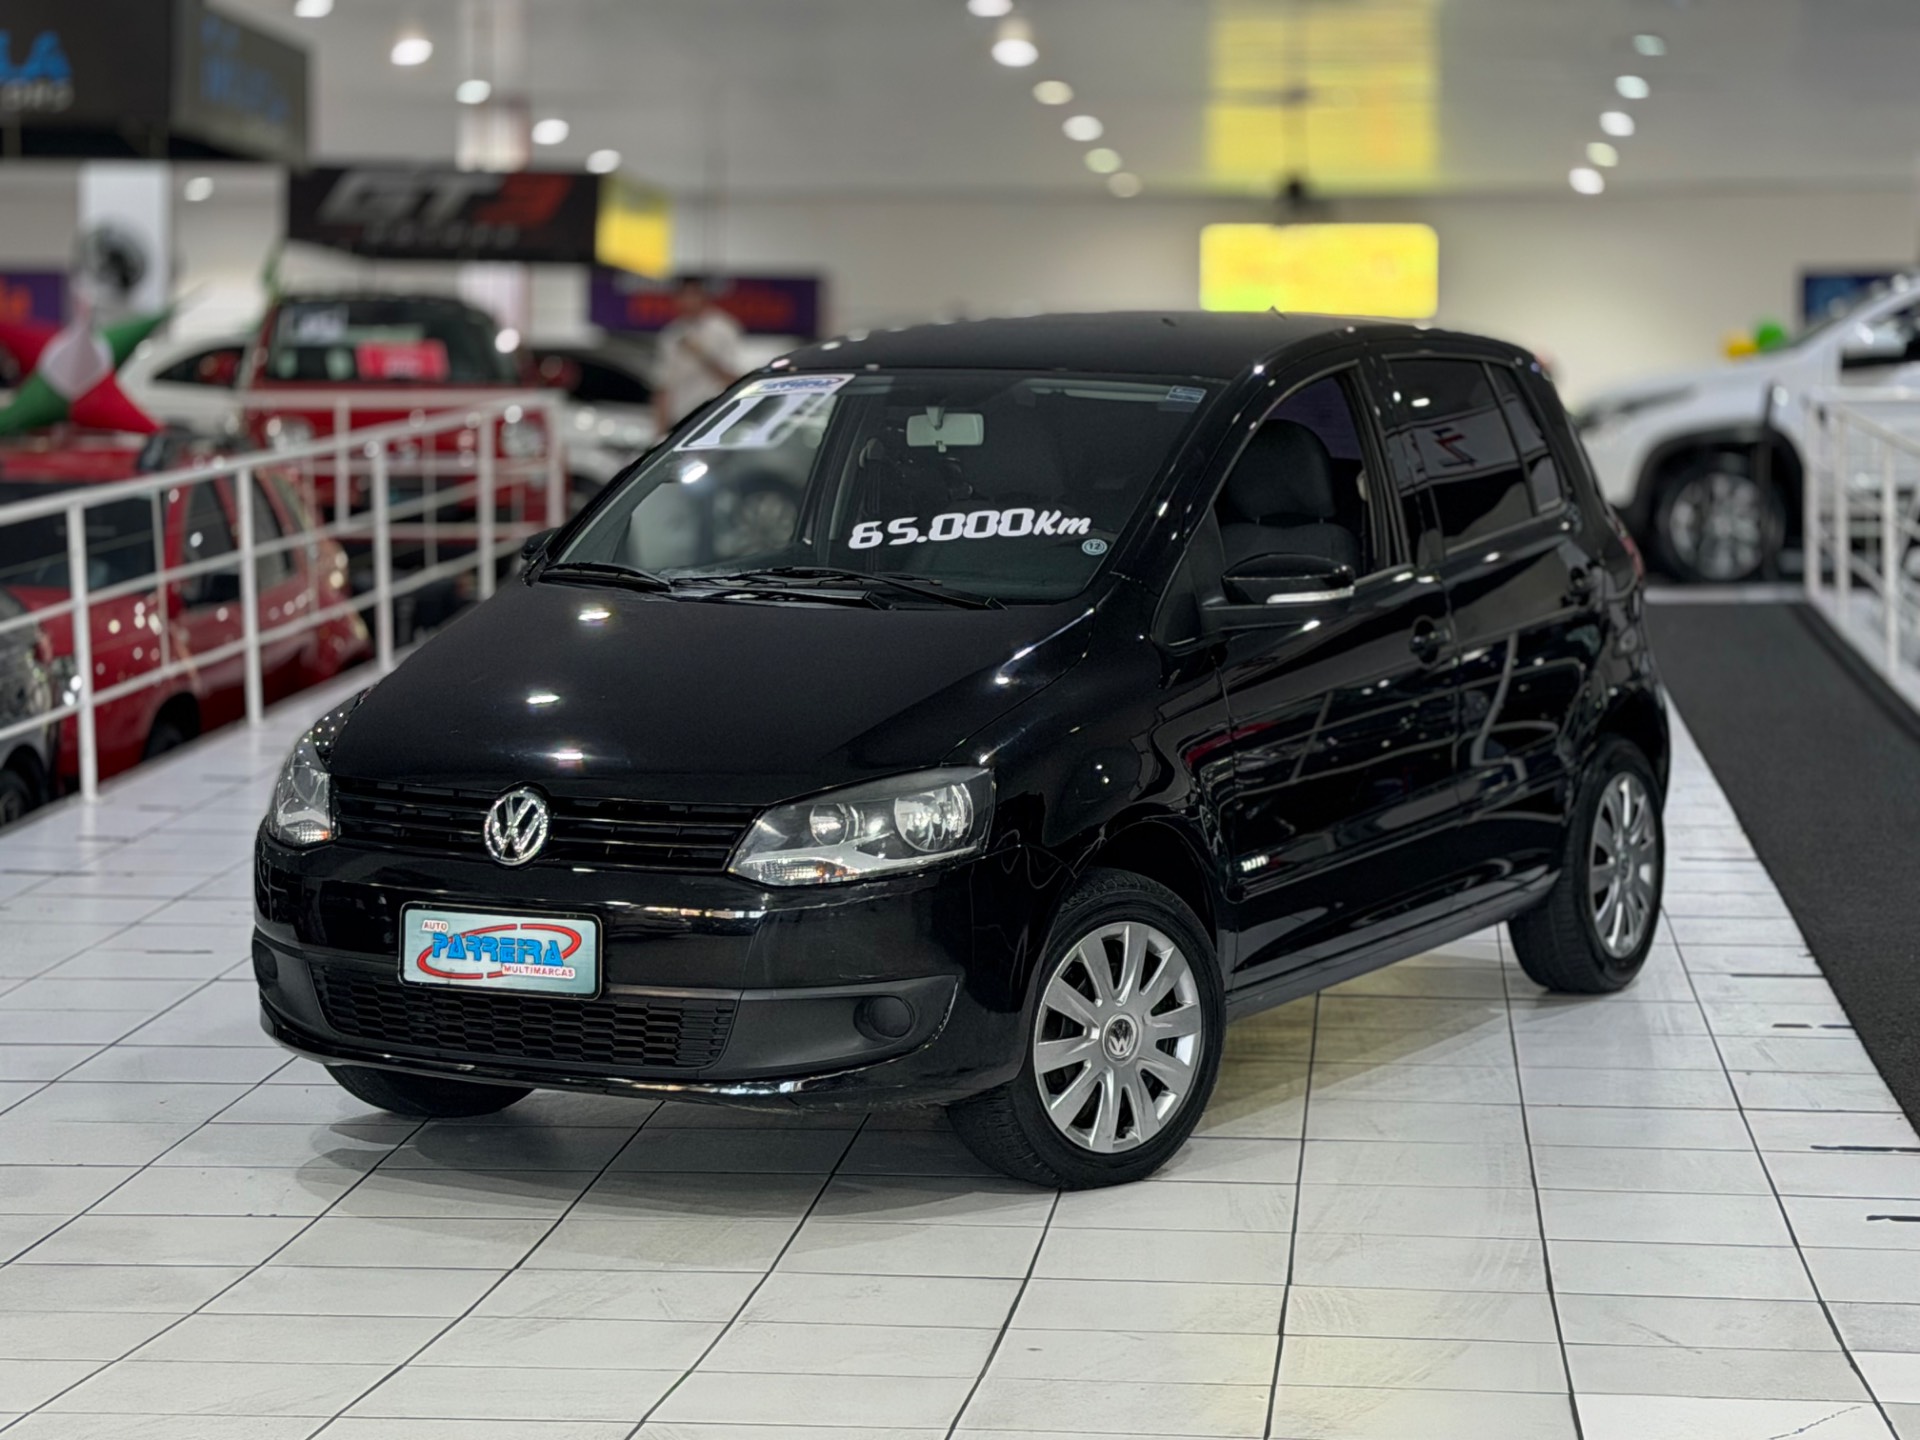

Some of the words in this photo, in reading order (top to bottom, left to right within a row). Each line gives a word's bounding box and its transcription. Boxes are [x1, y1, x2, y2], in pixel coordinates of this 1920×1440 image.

[423, 921, 447, 932] AUTO
[431, 932, 564, 967] PARREIRA
[503, 965, 574, 978] MULTIMARCAS
